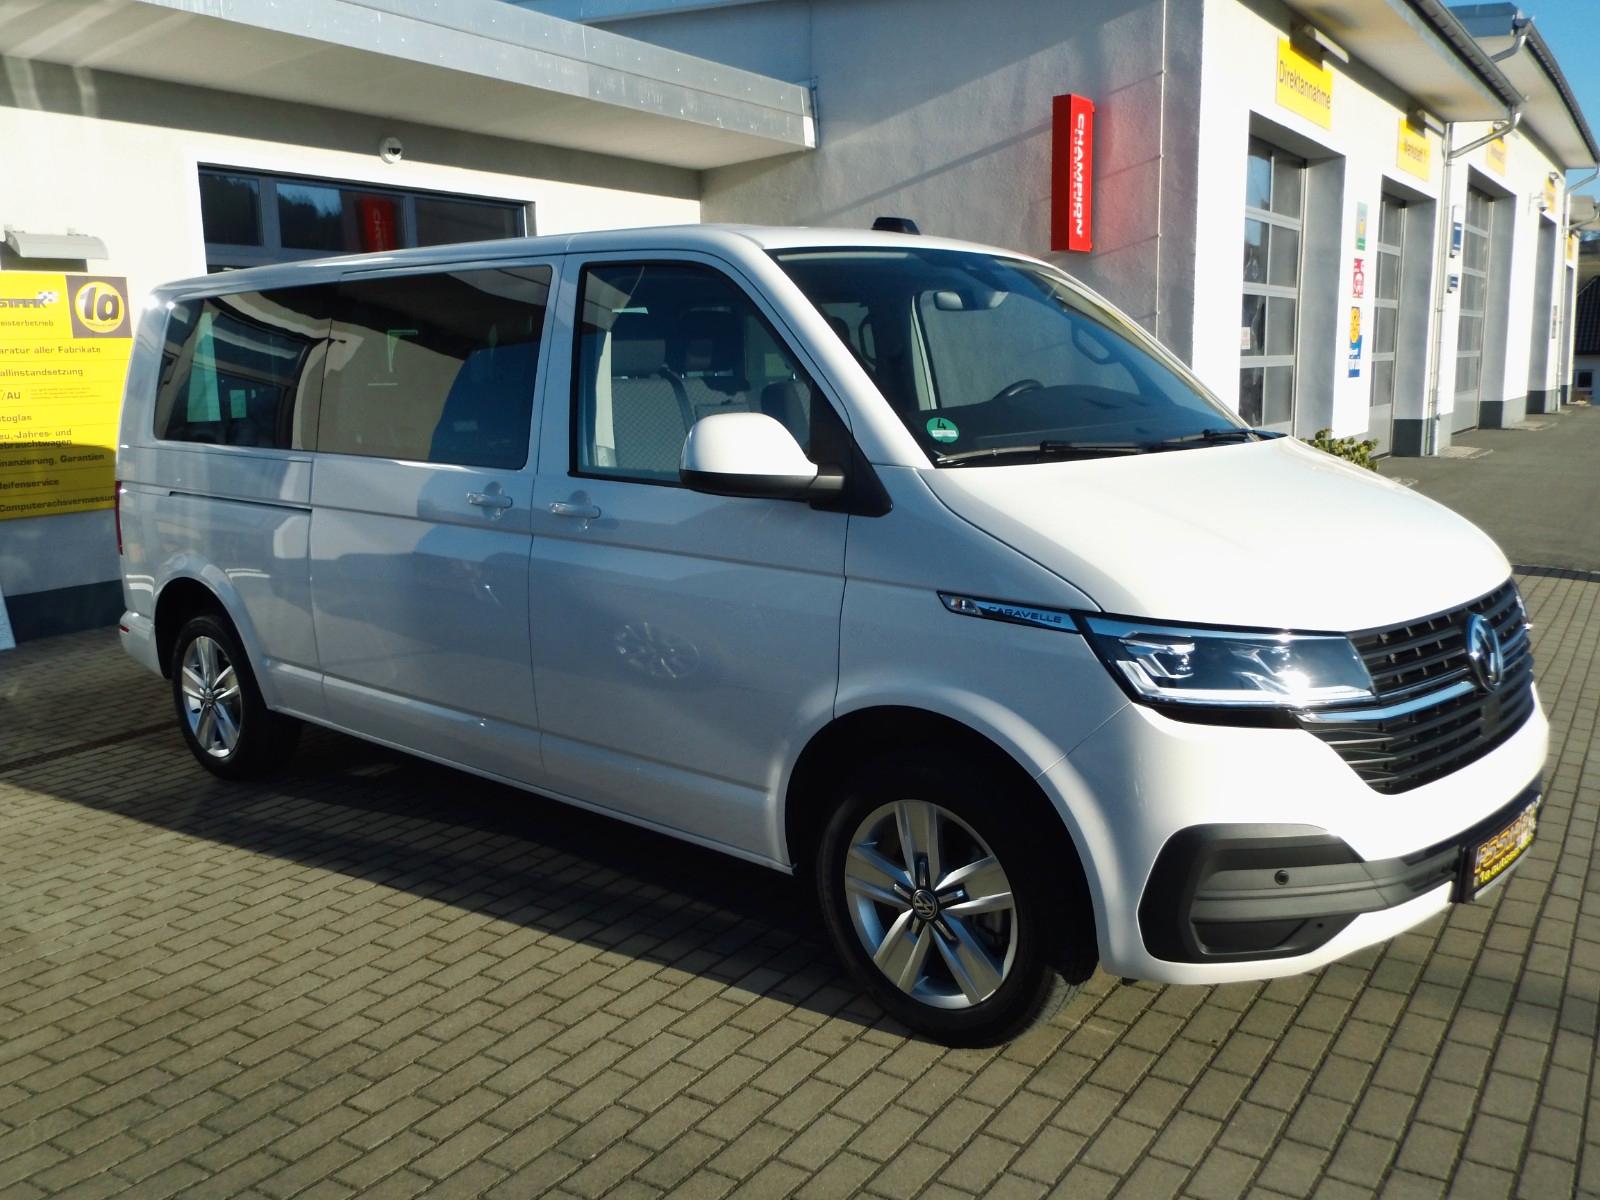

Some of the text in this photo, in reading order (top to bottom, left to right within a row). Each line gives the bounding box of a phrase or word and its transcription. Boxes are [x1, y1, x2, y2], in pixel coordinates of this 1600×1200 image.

[1279, 60, 1331, 110] Direktannahme
[1075, 113, 1086, 236] CHAMPION
[34, 346, 54, 354] aller
[58, 345, 101, 354] Fabrikate
[936, 418, 947, 430] 4
[55, 429, 72, 437] und
[60, 453, 105, 463] Garantien
[988, 606, 1063, 624] CARAVELLE
